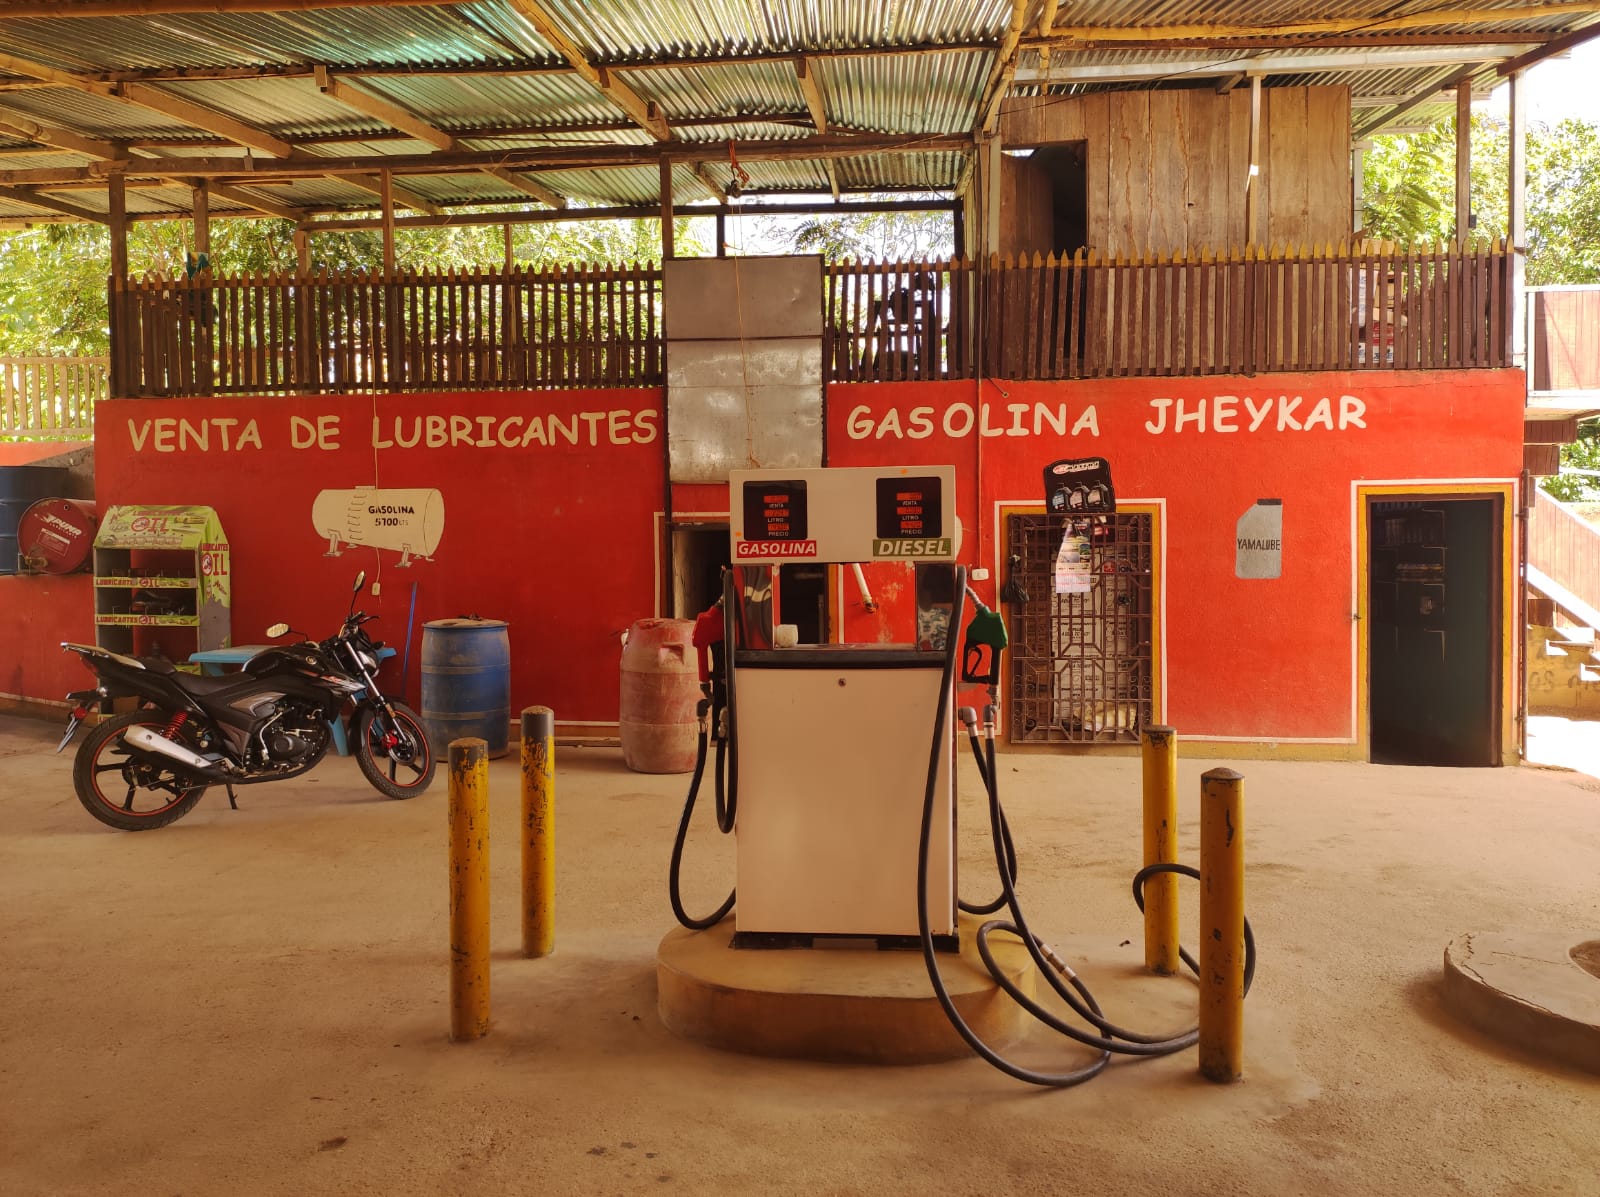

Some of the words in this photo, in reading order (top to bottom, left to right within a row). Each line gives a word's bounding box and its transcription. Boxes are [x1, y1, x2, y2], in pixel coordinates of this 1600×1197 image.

[847, 402, 1100, 440] GASOLINA
[1145, 395, 1367, 434] JHEYKAR
[128, 417, 262, 451] VENTA
[290, 415, 340, 450] DE
[372, 409, 658, 448] LUBRICANTES
[368, 505, 415, 515] GASOLINA
[738, 543, 816, 555] GASOLINA
[878, 540, 948, 555] DIESEL
[1237, 538, 1281, 551] YAMALUBE
[201, 553, 228, 576] OIL
